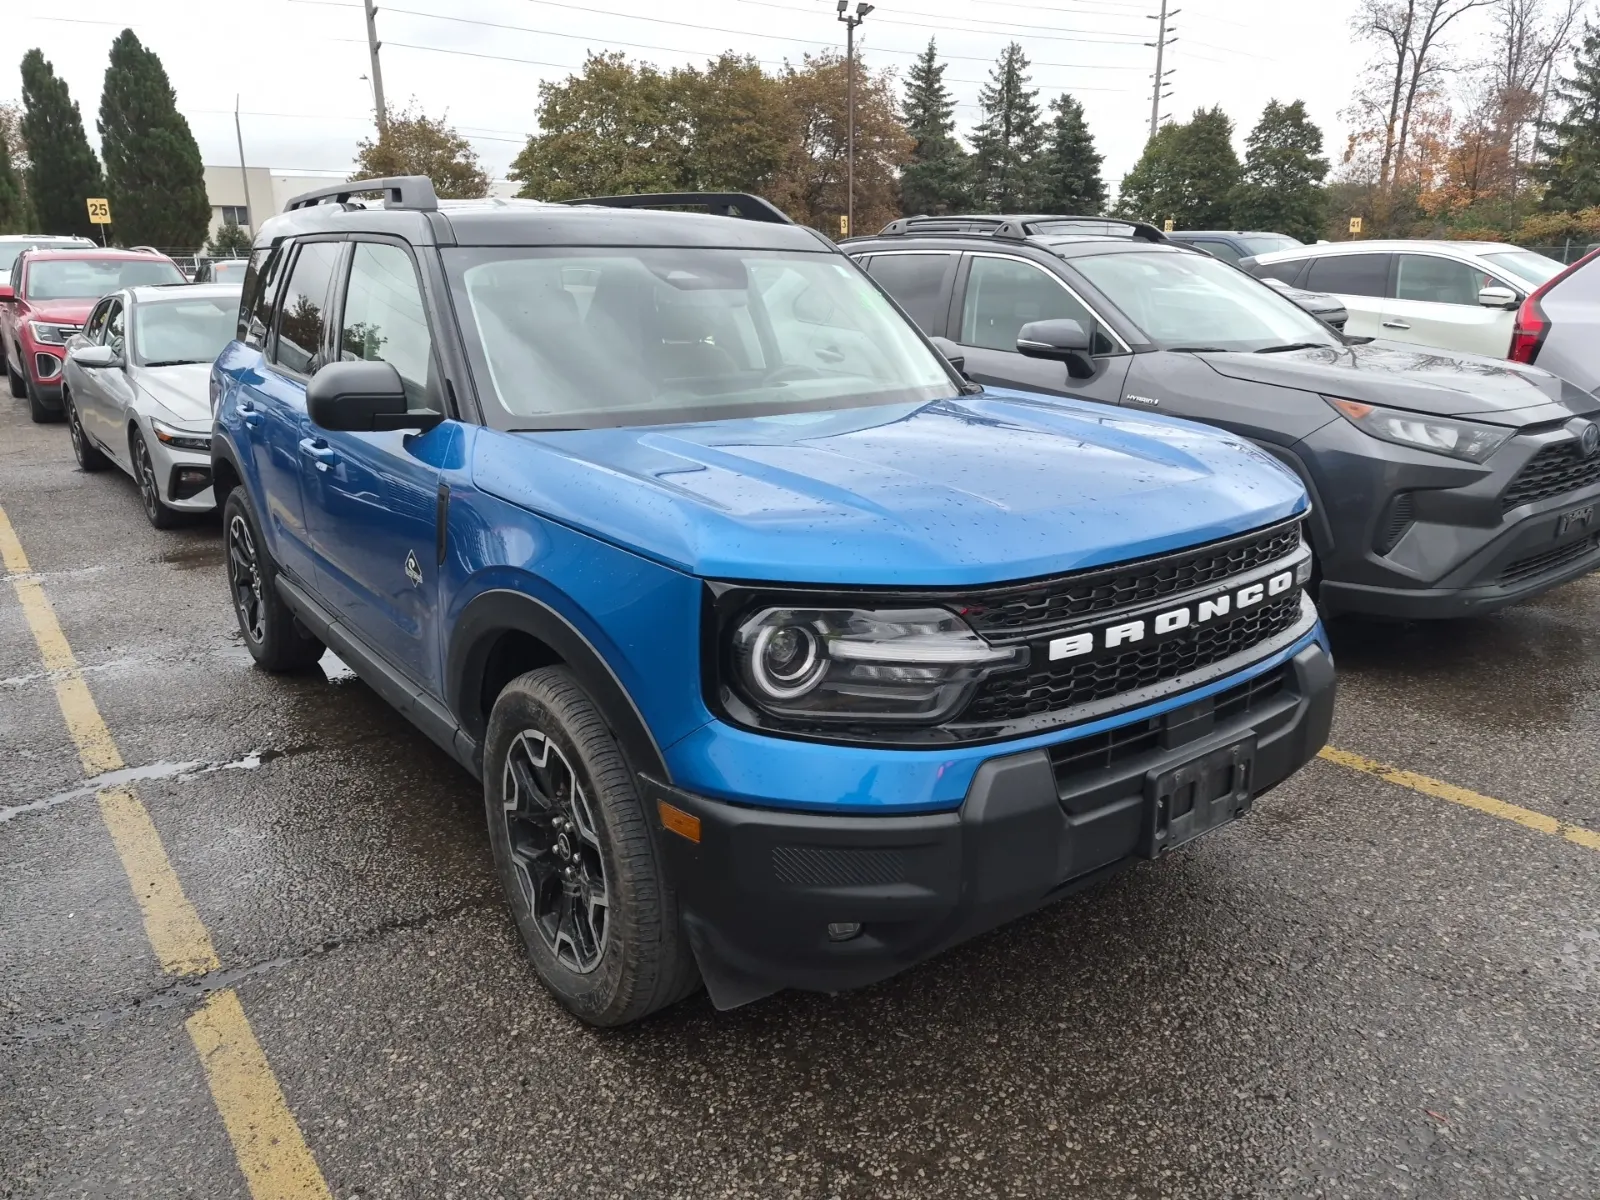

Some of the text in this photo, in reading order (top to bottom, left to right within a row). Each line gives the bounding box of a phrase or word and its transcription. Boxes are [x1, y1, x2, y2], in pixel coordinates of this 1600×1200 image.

[90, 203, 108, 216] 25
[1350, 220, 1360, 228] 41
[1126, 394, 1153, 404] HYBRID
[1049, 571, 1292, 661] BRONCO
